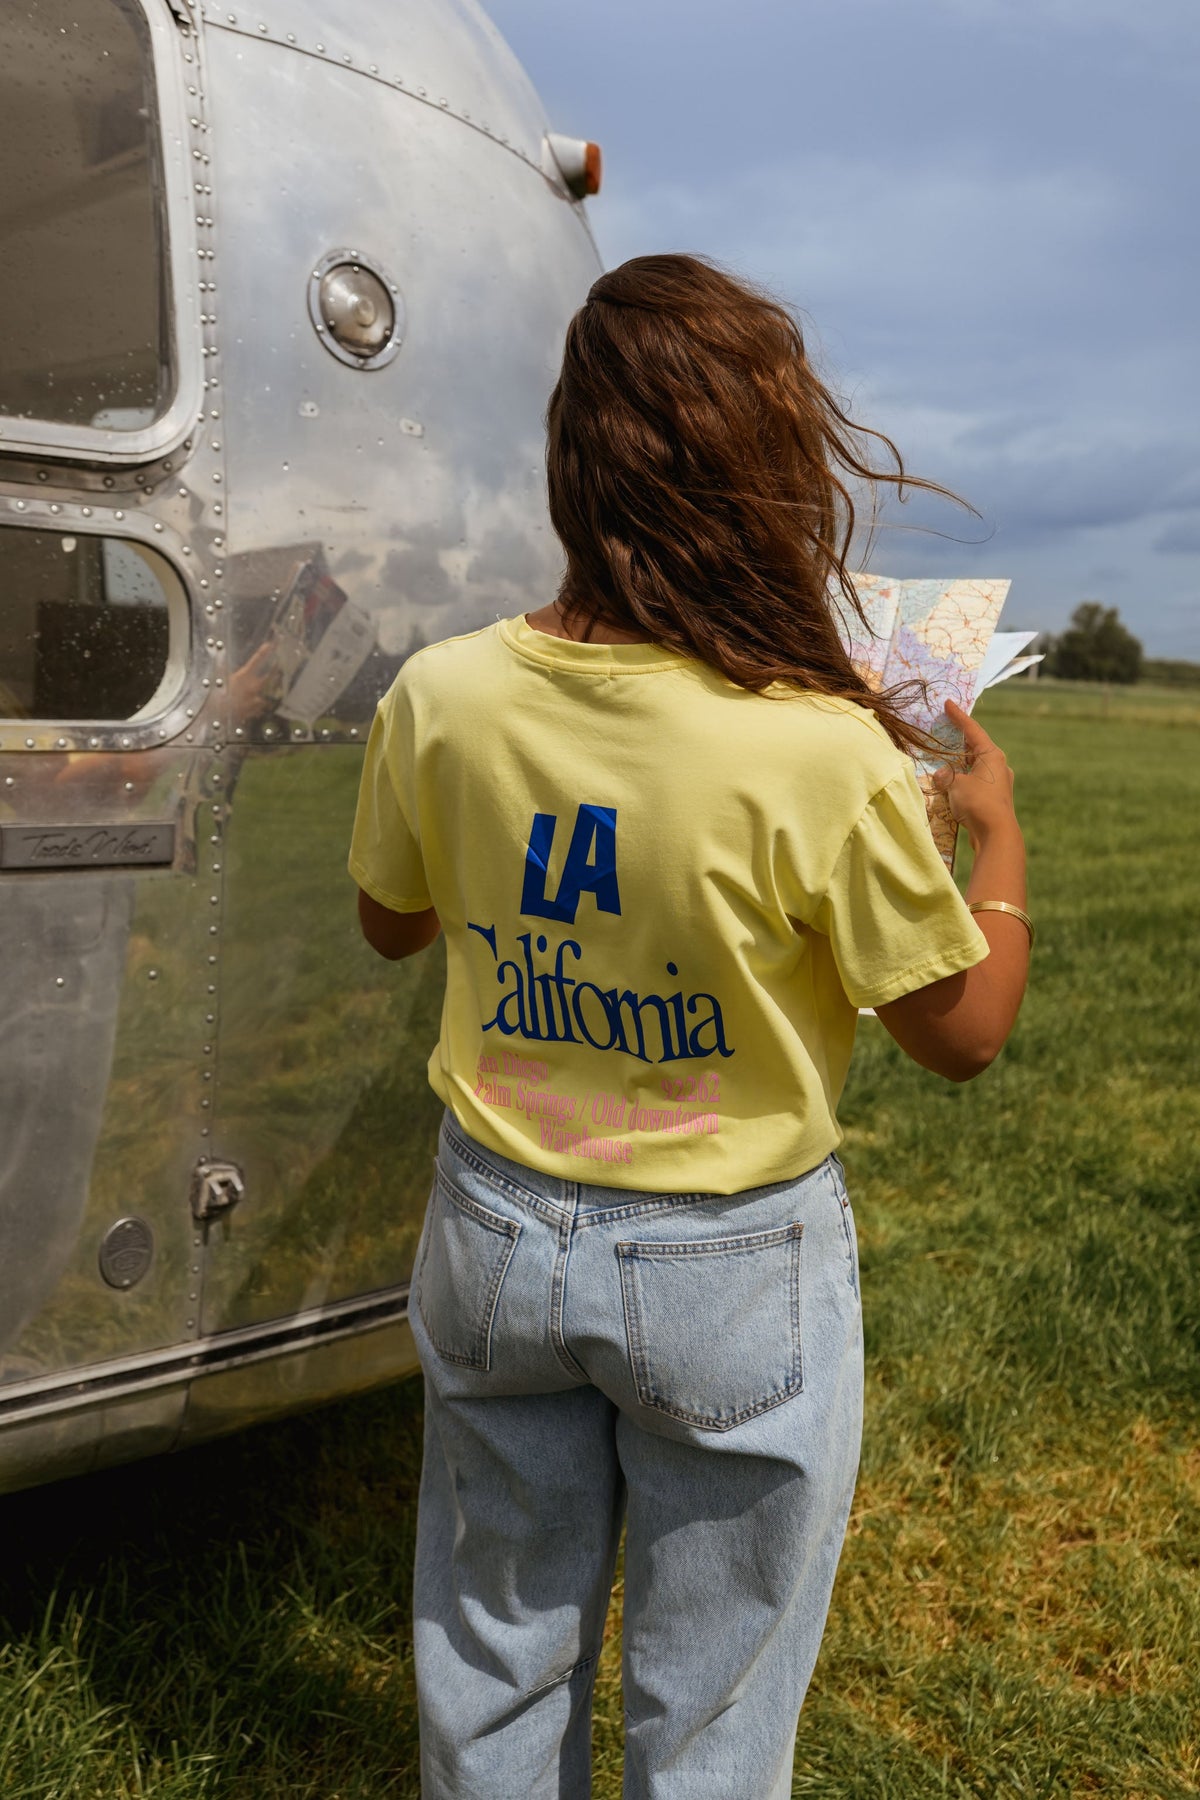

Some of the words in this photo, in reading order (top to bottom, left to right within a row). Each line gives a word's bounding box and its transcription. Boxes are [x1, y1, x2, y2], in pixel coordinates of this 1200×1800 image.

[520, 803, 622, 925] LA
[477, 1055, 499, 1074] an
[501, 1050, 548, 1087] Diego
[661, 1072, 720, 1103] 92262
[515, 1079, 577, 1126] Springs
[577, 1090, 592, 1122] /
[591, 1091, 627, 1129] Old
[627, 1097, 719, 1136] downtown
[538, 1117, 633, 1164] Warehouse
